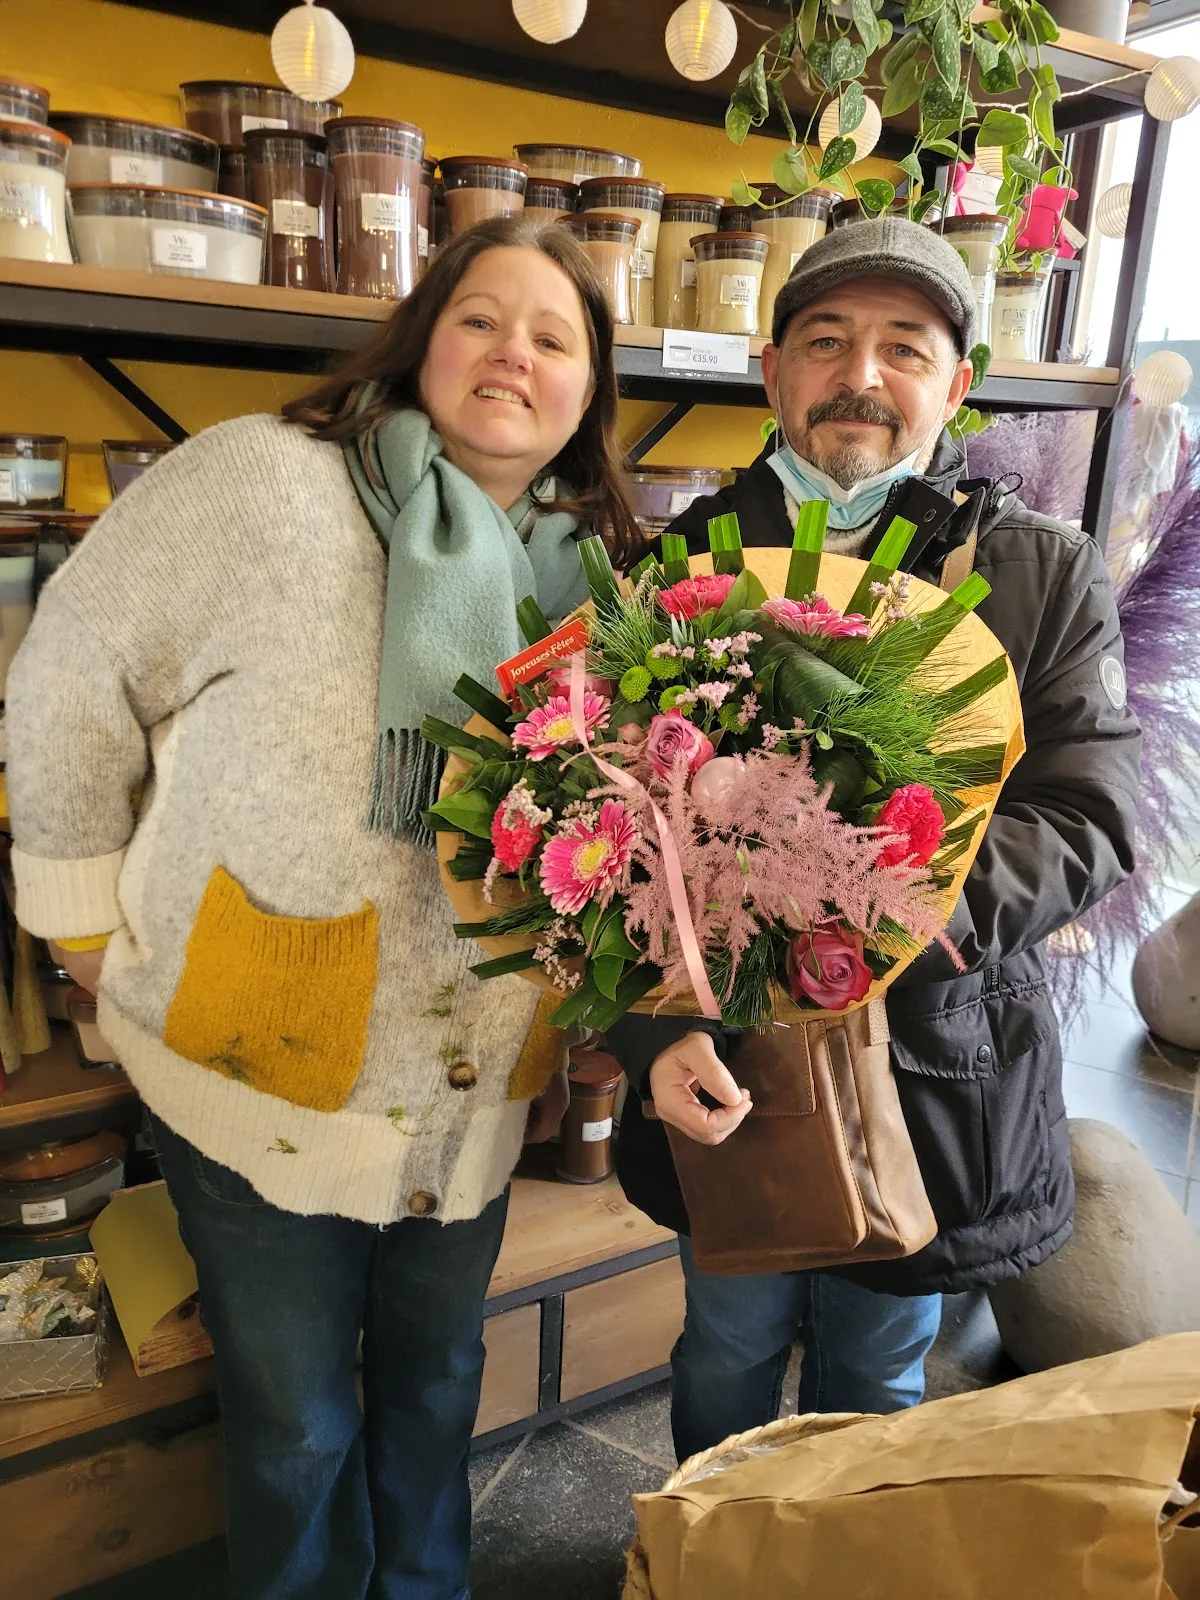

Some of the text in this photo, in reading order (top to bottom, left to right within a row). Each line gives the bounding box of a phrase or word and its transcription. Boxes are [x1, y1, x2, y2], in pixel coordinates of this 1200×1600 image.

[692, 354, 718, 364] €35.90
[510, 635, 575, 680] Joyeuses Fêtes
